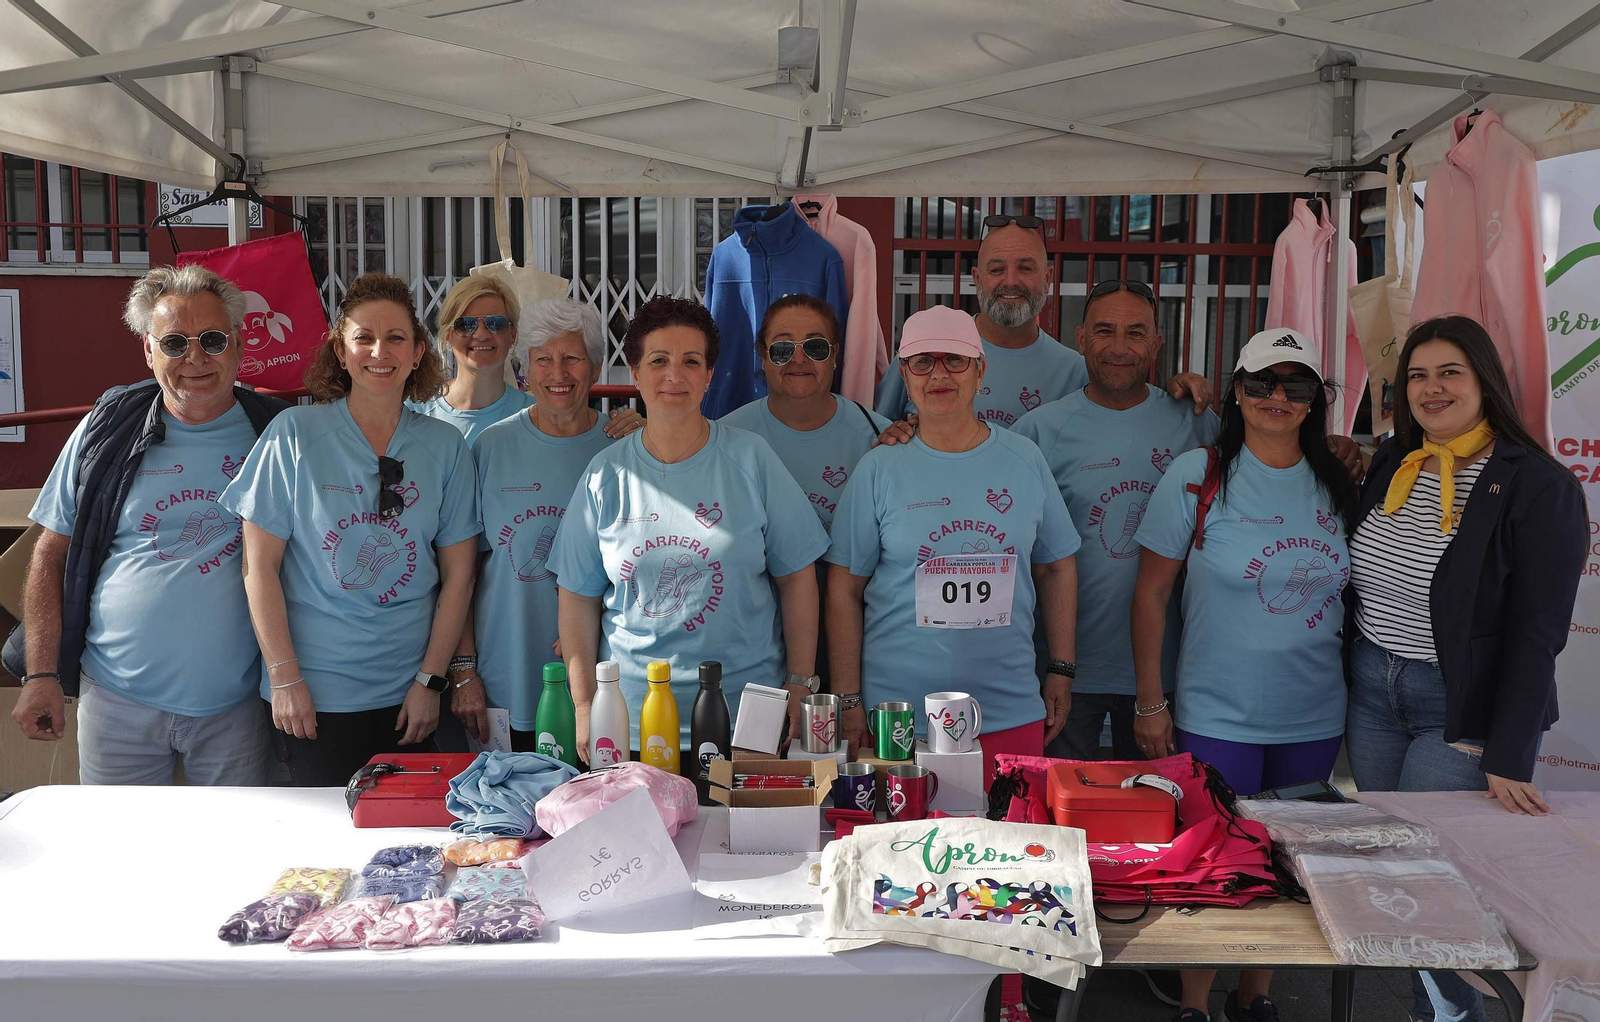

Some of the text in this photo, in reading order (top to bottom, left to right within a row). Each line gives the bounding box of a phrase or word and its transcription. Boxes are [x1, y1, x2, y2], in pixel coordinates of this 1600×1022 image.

[171, 188, 201, 206] San
[1272, 342, 1303, 350] adidas
[267, 353, 301, 367] APRON
[1553, 370, 1588, 400] CAMPO
[977, 409, 1019, 427] ARRE
[1553, 437, 1600, 458] CH
[138, 512, 153, 533] VIII
[155, 488, 219, 512] CARRE
[804, 491, 838, 514] ERA
[1088, 505, 1104, 527] VIII
[498, 525, 514, 547] VIII
[917, 545, 933, 567] VIII
[928, 519, 1007, 545] CARRERA
[321, 529, 340, 551] VIII
[378, 540, 418, 605] POPULAR
[926, 557, 946, 567] VIII
[1243, 557, 1264, 580] VIII
[1262, 537, 1341, 564] CARRERA
[925, 567, 958, 575] PUENTE
[960, 566, 997, 575] MAYORGA
[619, 535, 724, 632] VIII CARRERA POPULAR
[942, 580, 991, 604] 019
[1569, 623, 1600, 635] Onco
[891, 827, 1025, 874] Apron
[718, 903, 812, 912] MONEDEROS
